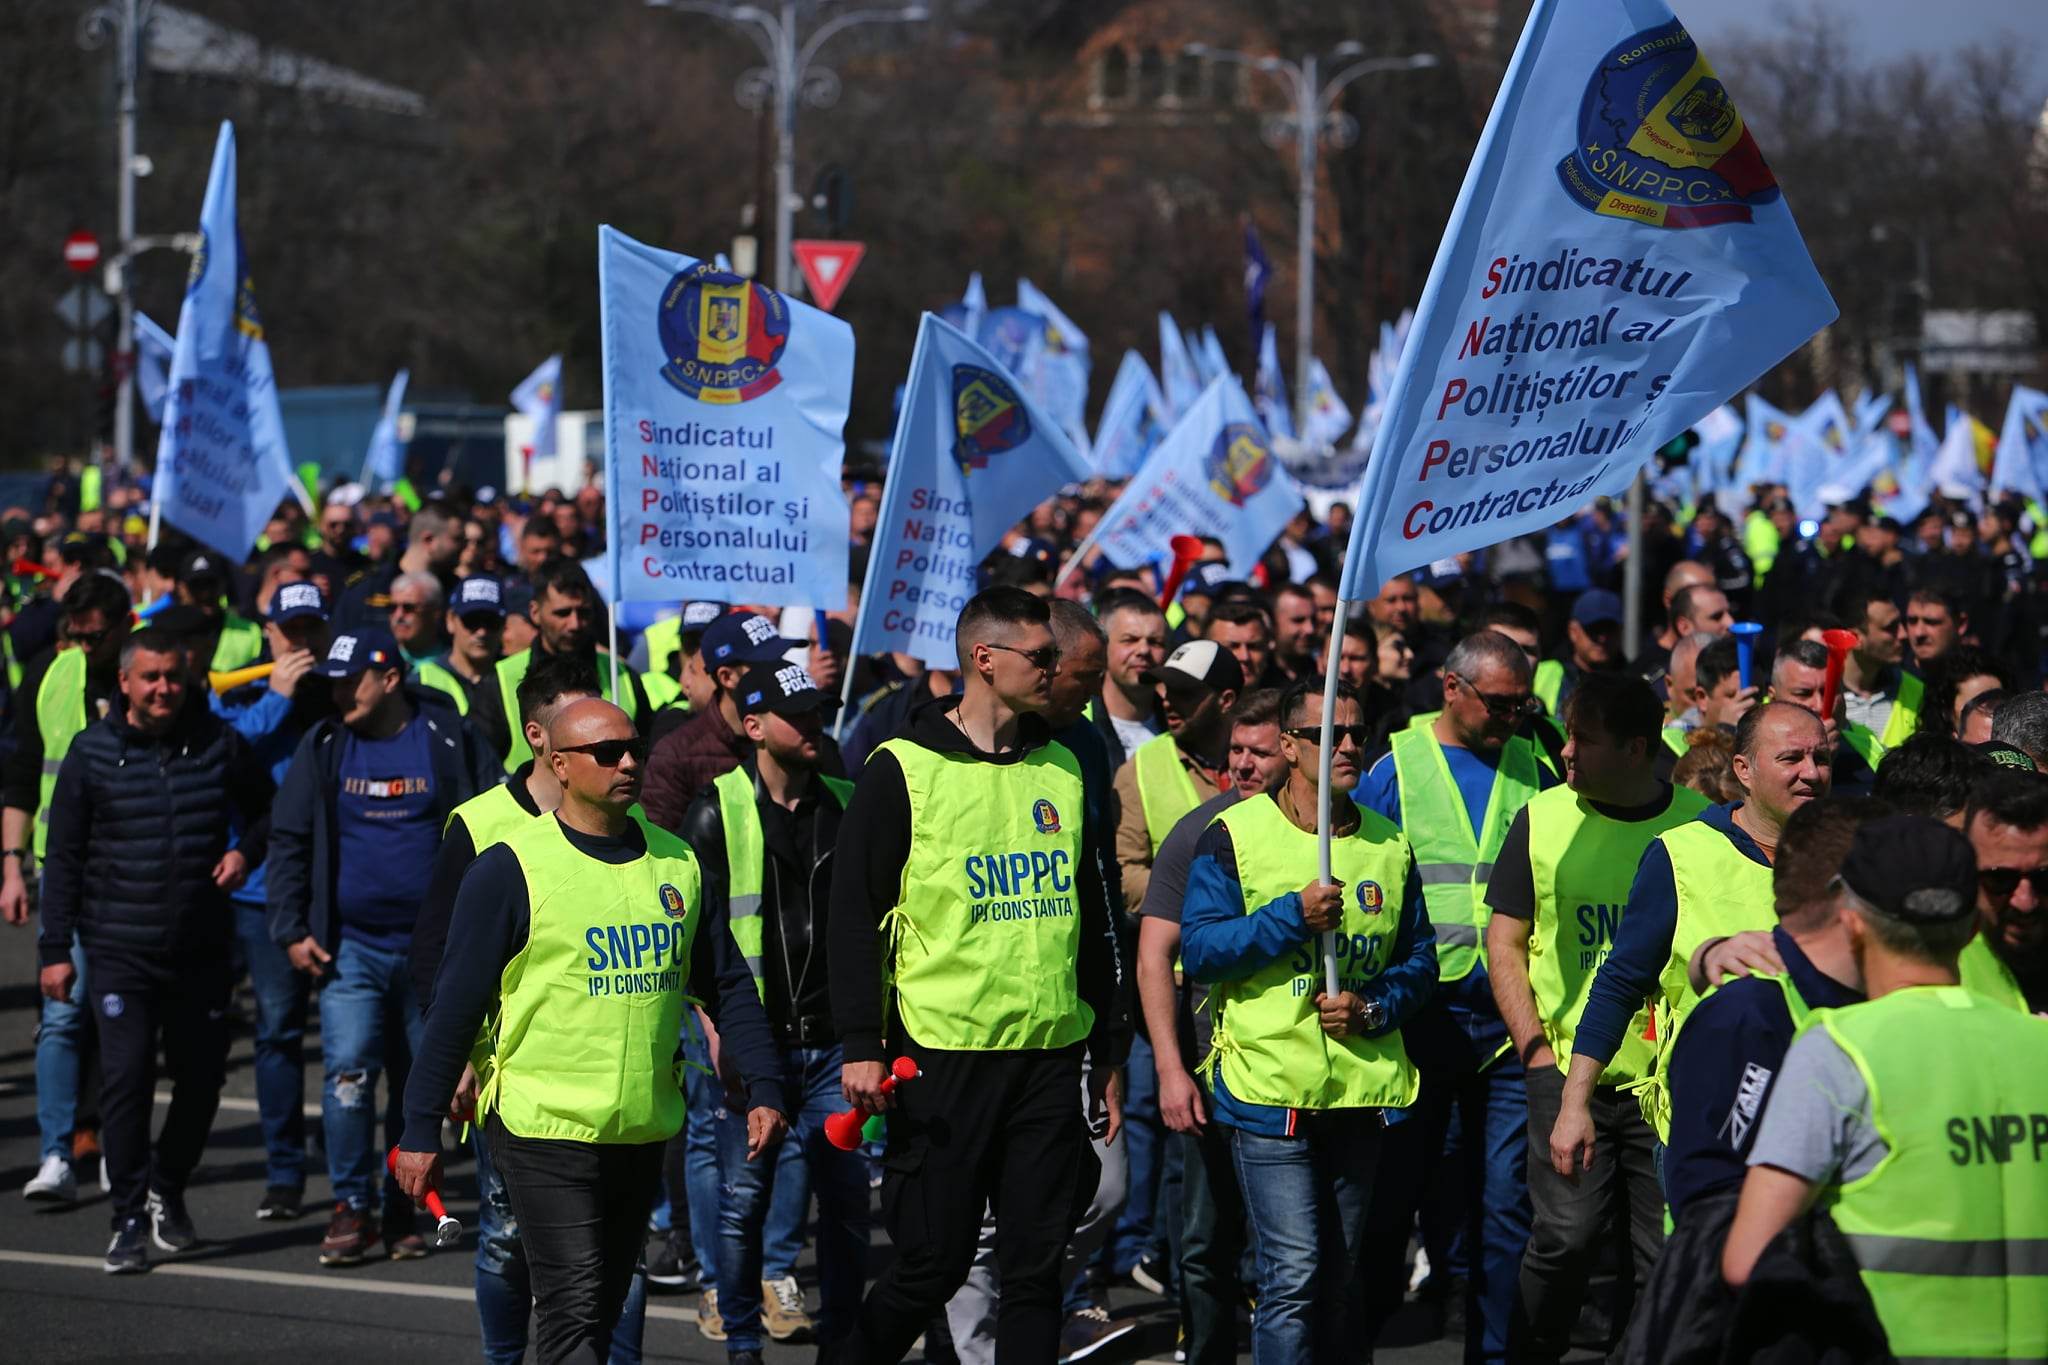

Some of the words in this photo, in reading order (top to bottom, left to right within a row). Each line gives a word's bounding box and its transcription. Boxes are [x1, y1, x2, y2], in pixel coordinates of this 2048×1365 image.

[1608, 198, 1658, 218] Dreptate
[1482, 248, 1693, 299] Sindicatul
[1458, 307, 1620, 367] Național
[1621, 318, 1676, 343] al
[1436, 366, 1638, 428] Polițiștilor
[1643, 373, 1673, 413] ș
[639, 420, 773, 450] Sindicatul
[642, 455, 746, 486] Național
[757, 462, 780, 483] al
[642, 489, 772, 520] Polițiștilor
[783, 498, 809, 526] și
[910, 488, 973, 517] Sind
[1403, 462, 1610, 540] Contractual
[640, 524, 808, 553] Personalului
[903, 518, 975, 549] Națio
[643, 557, 795, 584] Contractual
[896, 550, 978, 589] Polițiș
[889, 580, 966, 612] Perso
[883, 610, 956, 643] Contr
[966, 850, 1071, 899] SNPPC
[971, 903, 988, 924] IPJ
[991, 897, 1073, 922] CONSTANTA
[1576, 903, 1628, 947] SN
[585, 922, 685, 971] SNPPC
[588, 977, 610, 996] IPJ
[1946, 1113, 2048, 1166] SNPP
